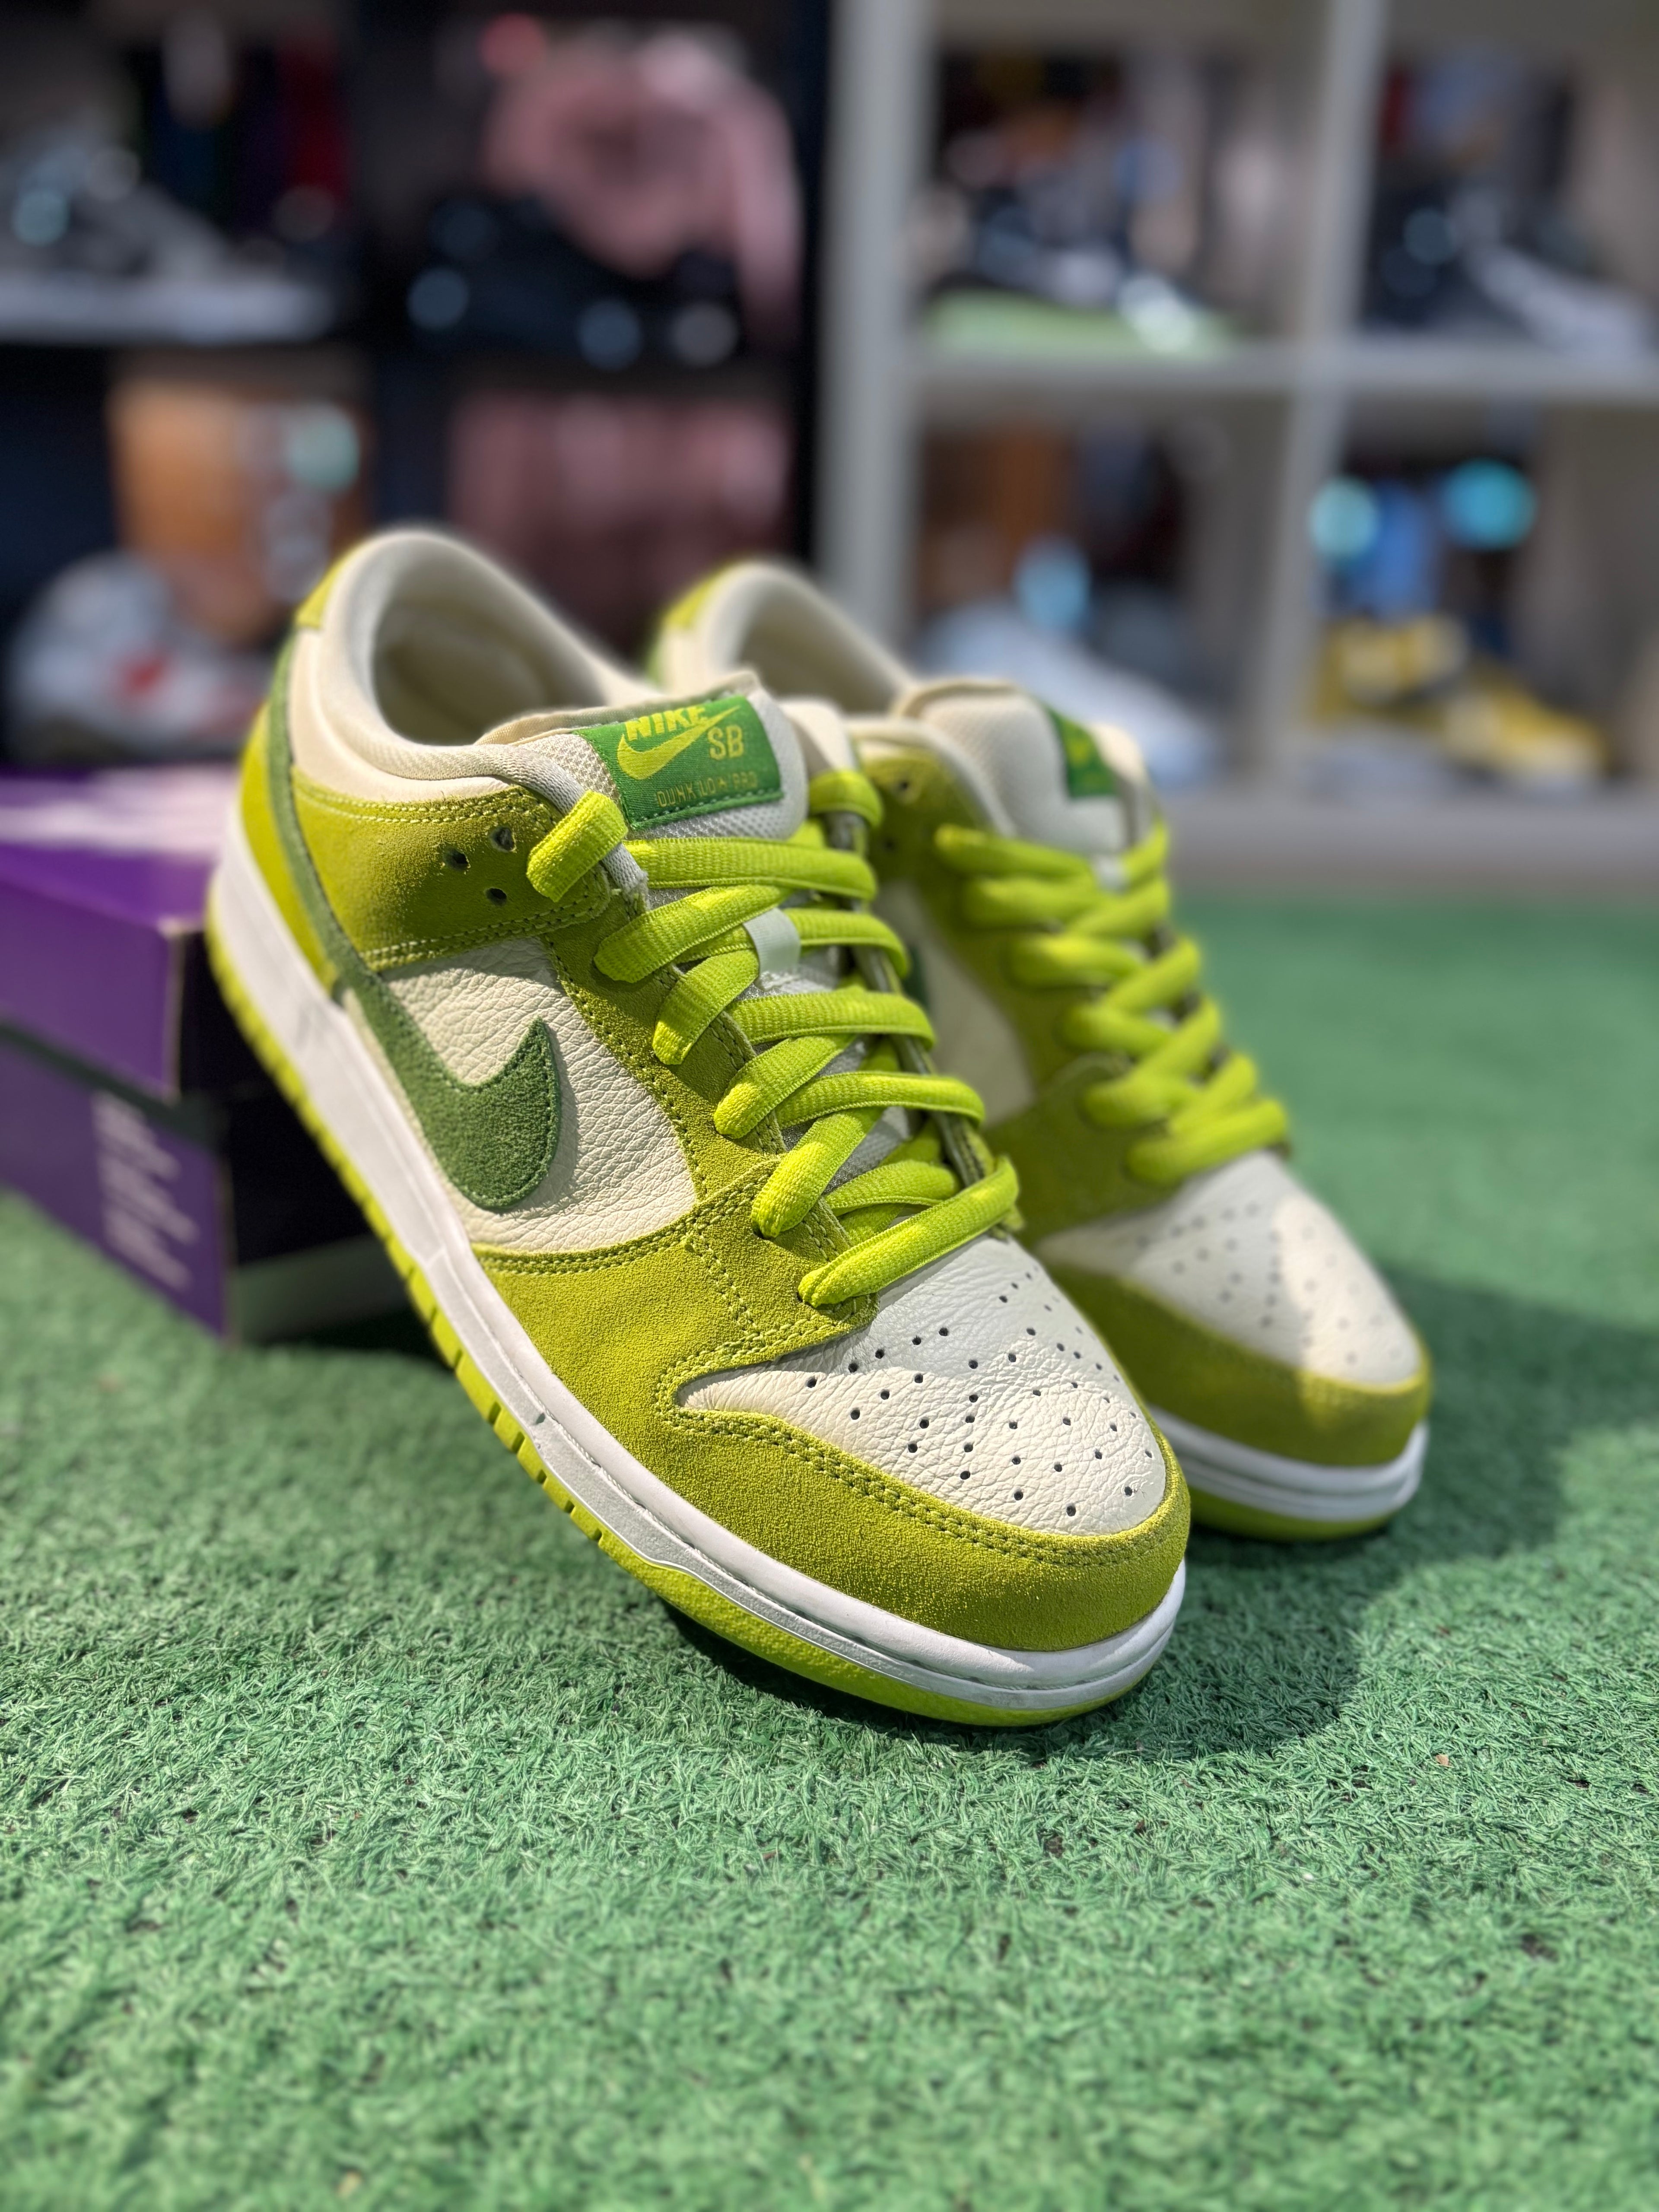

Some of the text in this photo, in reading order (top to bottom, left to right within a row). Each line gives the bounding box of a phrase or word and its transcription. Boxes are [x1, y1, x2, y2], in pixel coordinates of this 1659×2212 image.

[625, 706, 708, 741] NIKE
[707, 725, 744, 760] SB
[656, 782, 697, 807] DUNK
